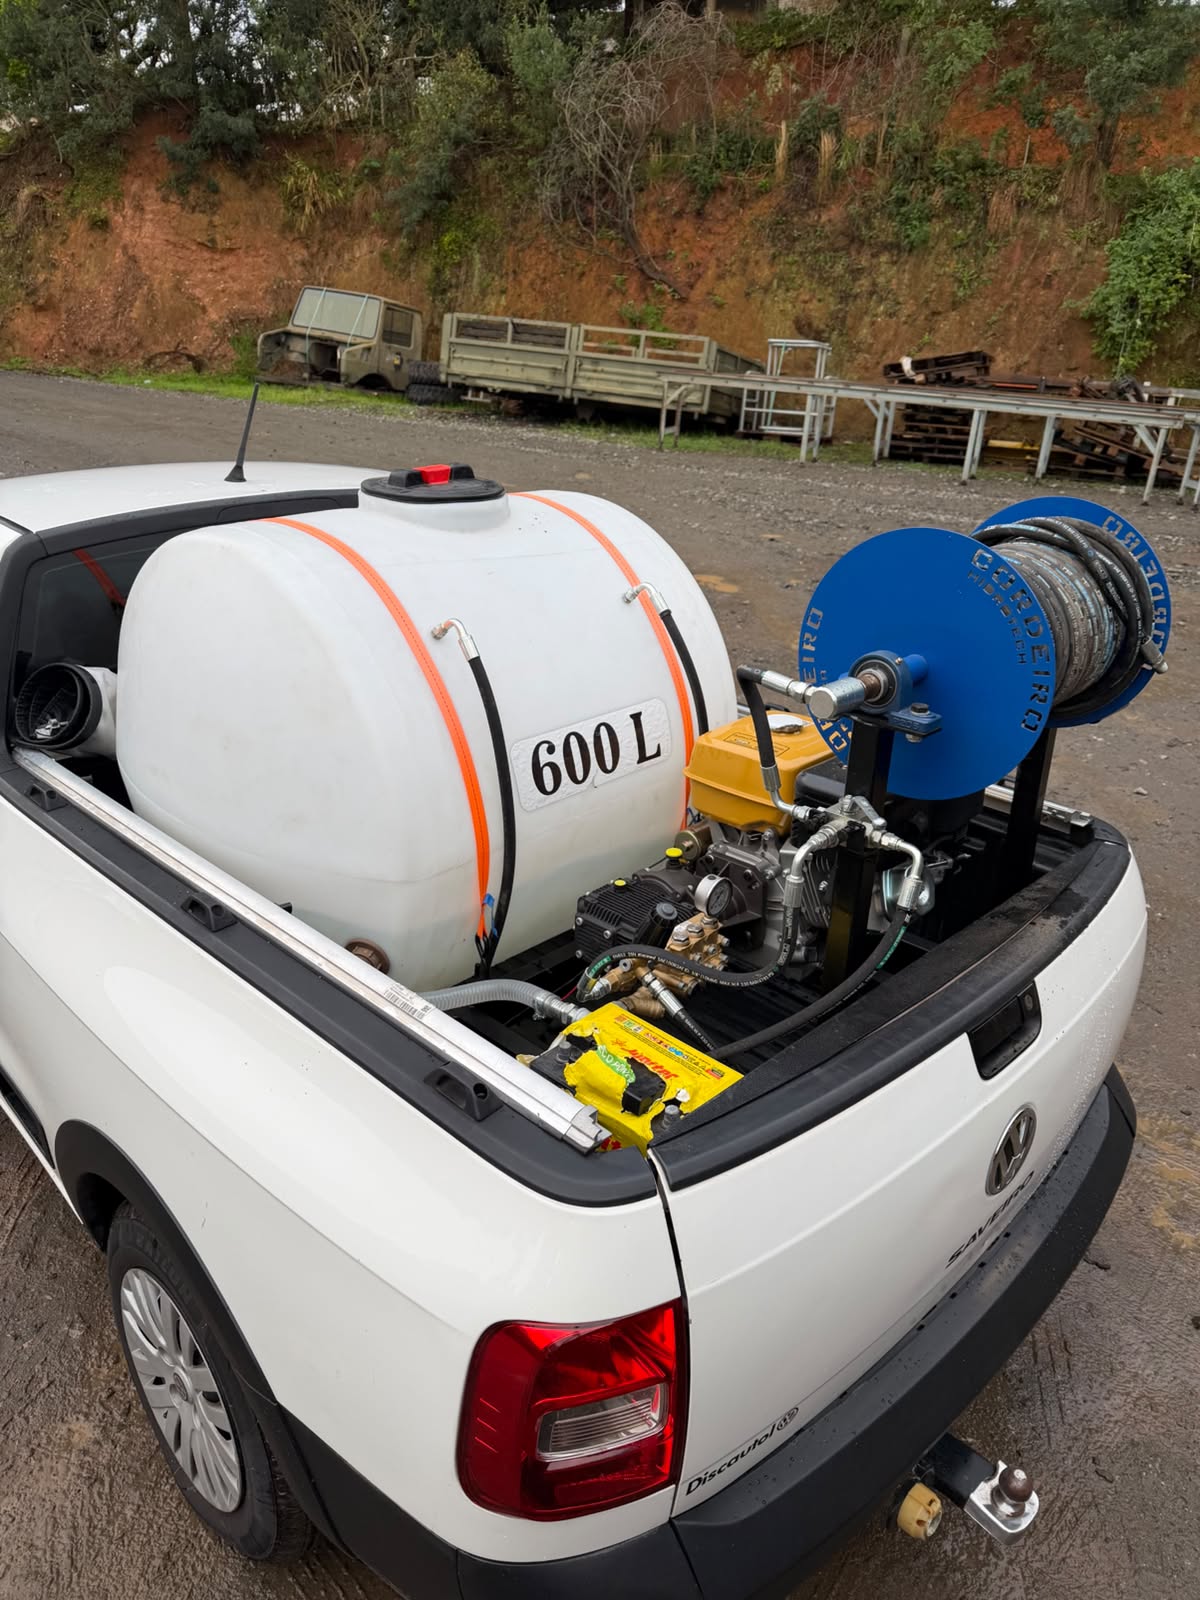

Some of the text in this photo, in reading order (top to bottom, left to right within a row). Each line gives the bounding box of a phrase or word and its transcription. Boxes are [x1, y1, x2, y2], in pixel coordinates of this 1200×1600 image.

[971, 548, 1051, 732] CORDEIRO
[532, 711, 661, 795] 600 L
[945, 1170, 1035, 1269] SAVEIRO
[685, 1424, 776, 1496] Discautol
